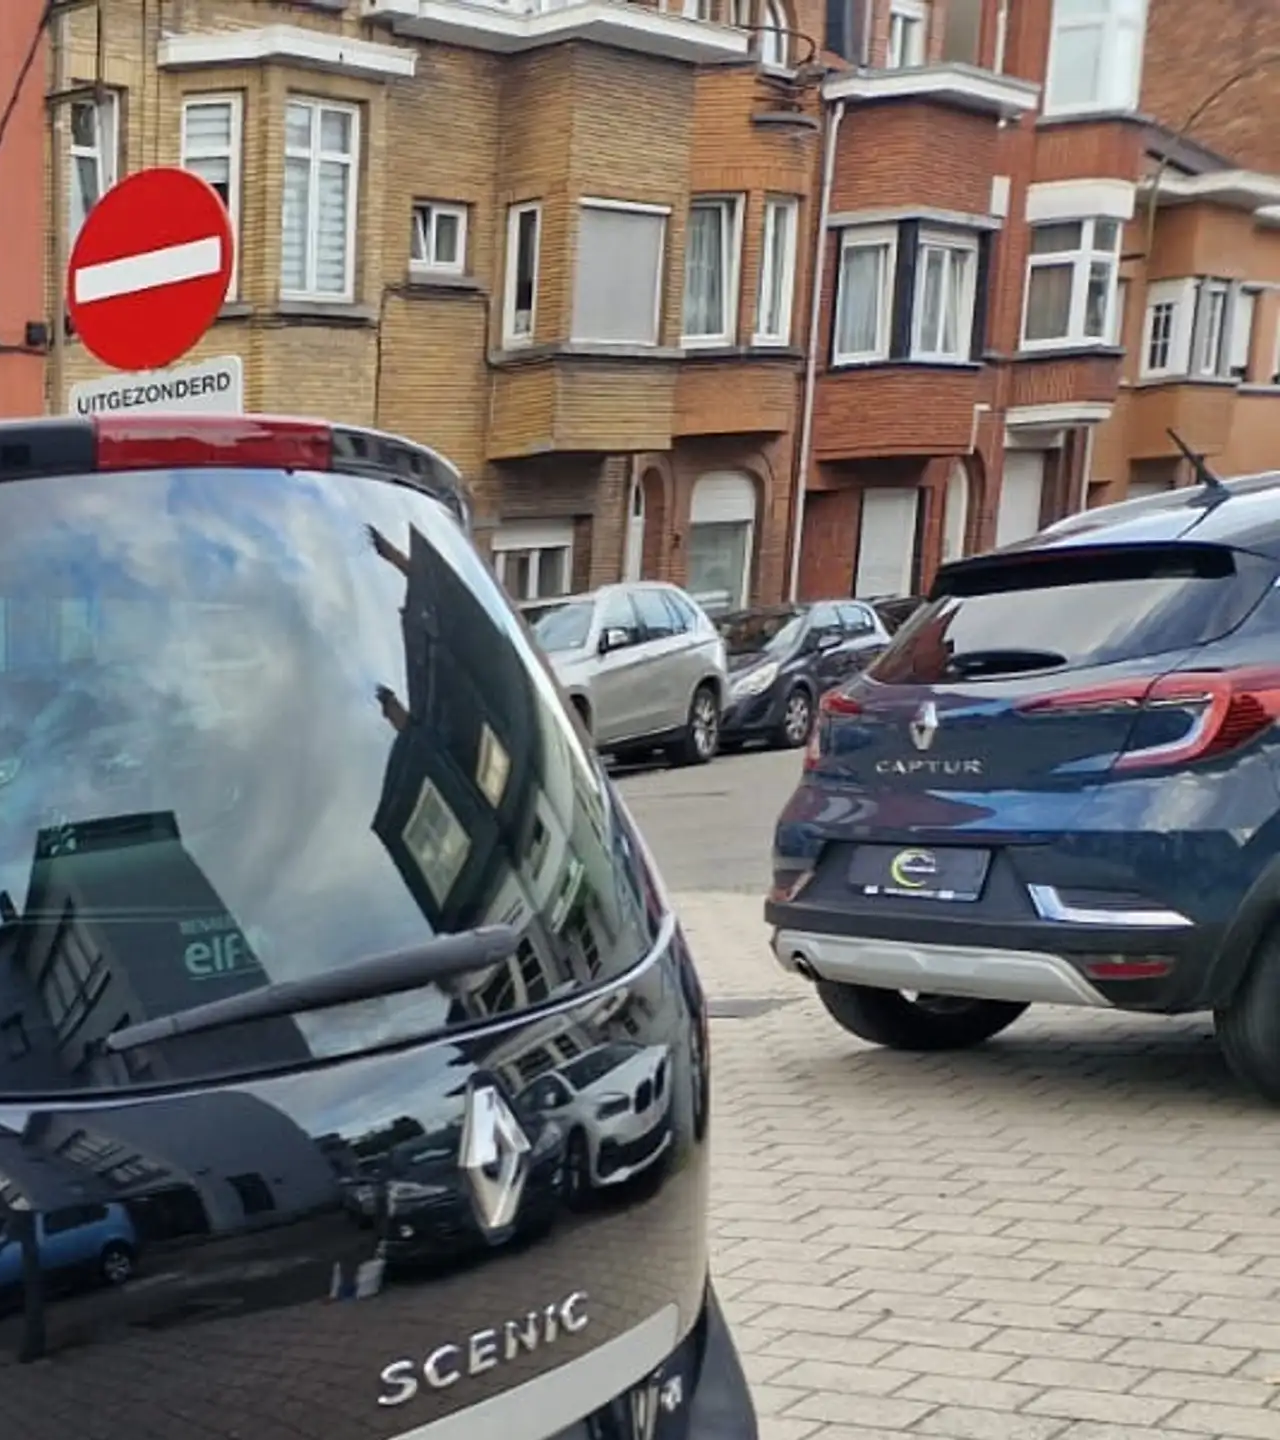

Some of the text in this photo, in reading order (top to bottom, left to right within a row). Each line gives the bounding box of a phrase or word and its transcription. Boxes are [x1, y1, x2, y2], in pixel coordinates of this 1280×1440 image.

[77, 371, 231, 415] UITGEZONDERD
[874, 758, 984, 776] CAPTUR
[377, 1290, 590, 1406] SCENIC
